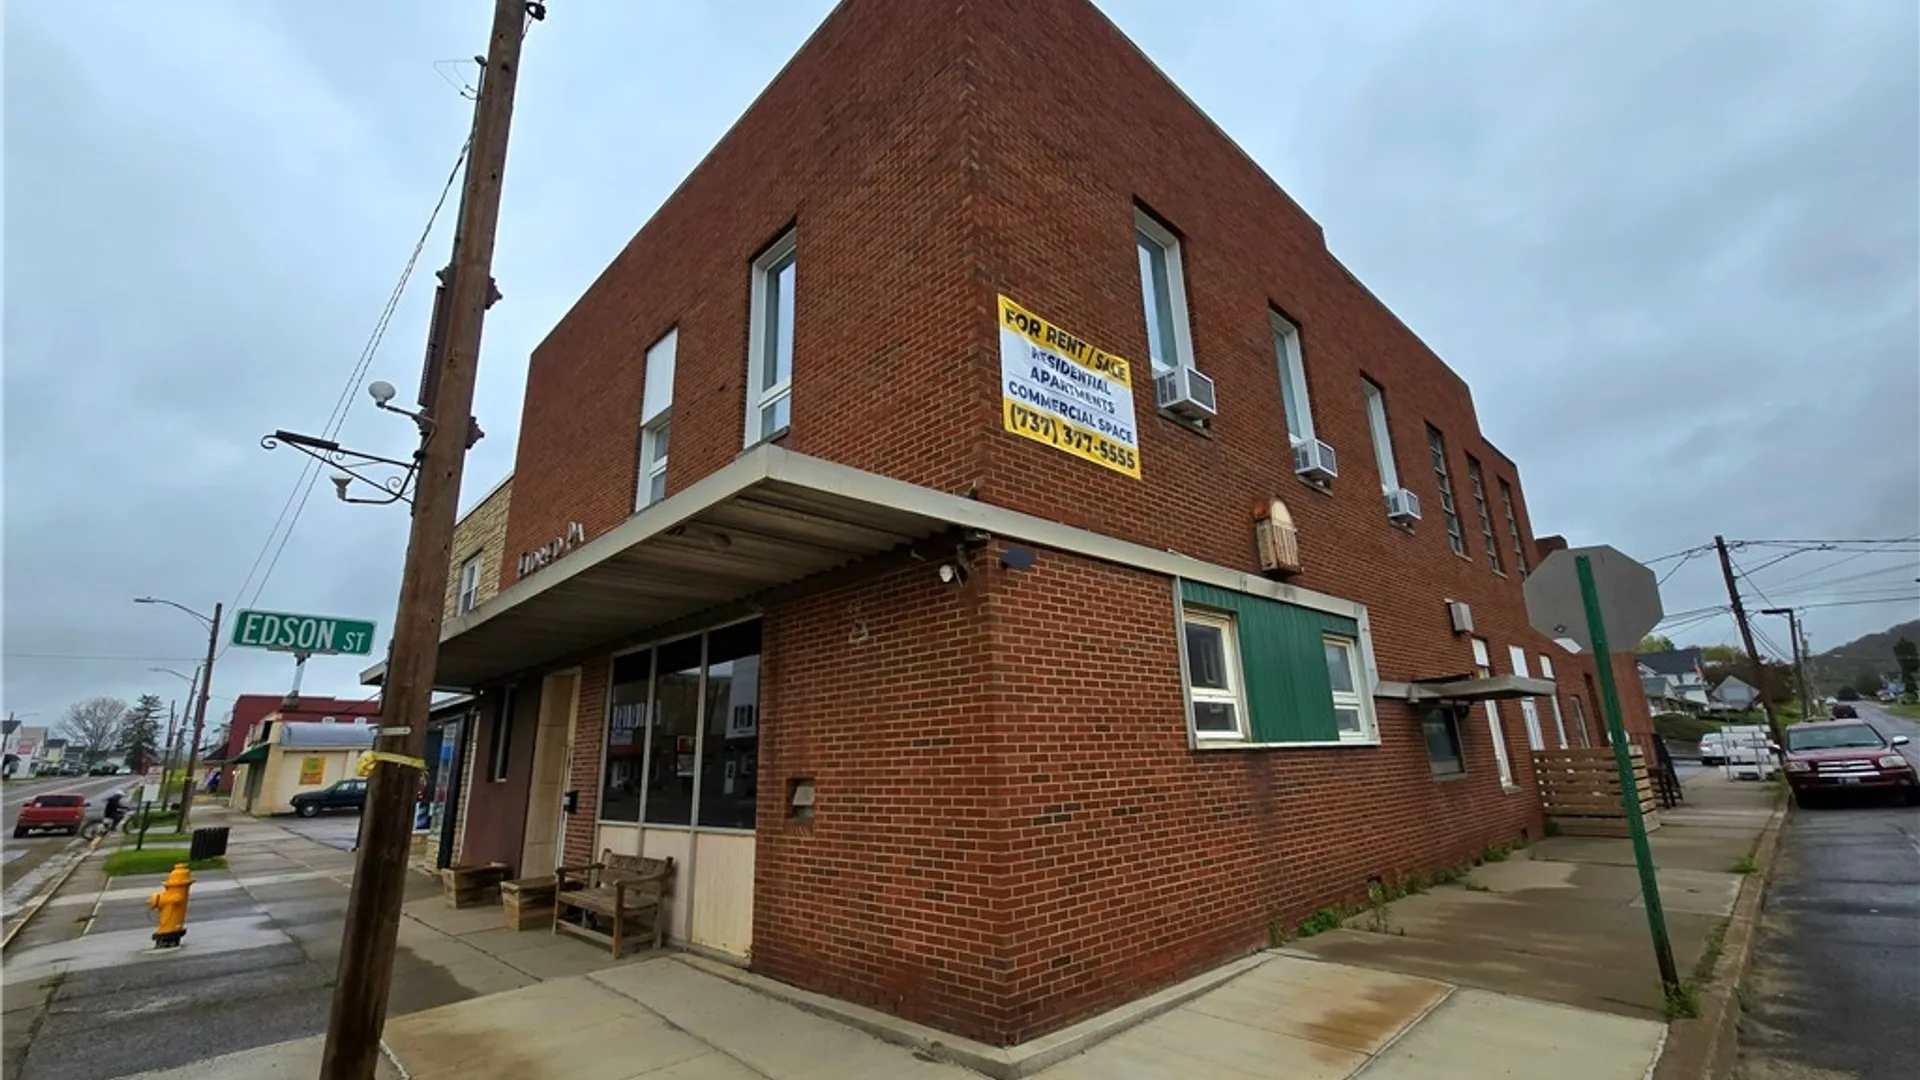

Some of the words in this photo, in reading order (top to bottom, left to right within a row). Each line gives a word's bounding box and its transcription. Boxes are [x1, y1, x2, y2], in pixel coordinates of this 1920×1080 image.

[1005, 307, 1041, 338] FOR
[1046, 325, 1086, 359] RENT
[1095, 353, 1126, 381] SALE
[1031, 347, 1111, 395] RESIDENTIAL
[1008, 380, 1096, 427] COMMERCIAL
[1098, 418, 1134, 444] SPACE
[1030, 367, 1115, 414] APARTMENTS
[1010, 403, 1058, 444] (737)
[1062, 425, 1136, 469] 377-5555
[241, 614, 337, 649] EDSON
[343, 631, 366, 651] ST
